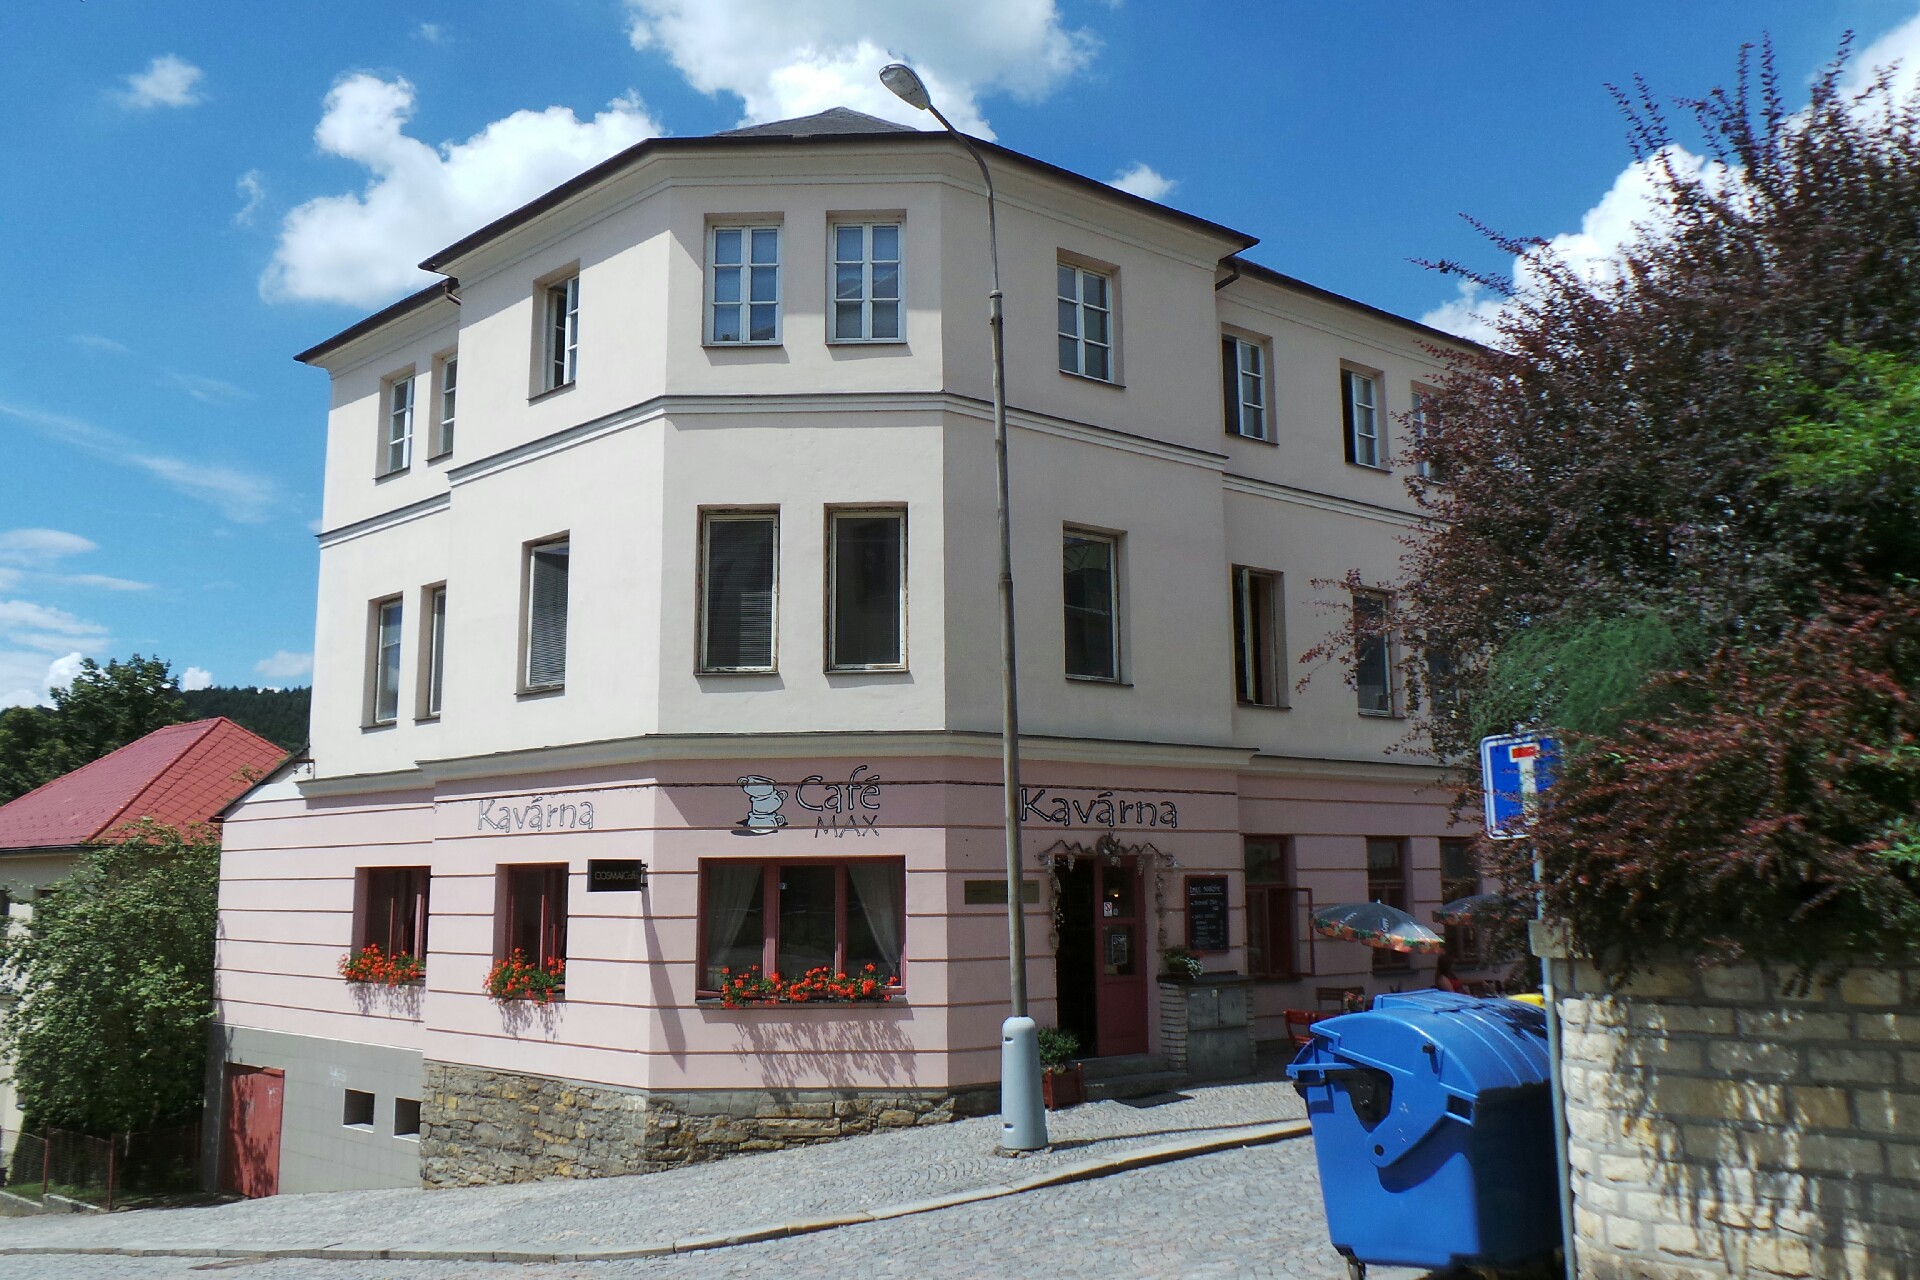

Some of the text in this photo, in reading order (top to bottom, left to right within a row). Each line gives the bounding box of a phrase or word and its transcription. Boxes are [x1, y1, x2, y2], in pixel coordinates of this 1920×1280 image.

[796, 765, 880, 813] Café
[1020, 788, 1177, 828] Kavárna
[478, 796, 594, 833] Kavárna
[814, 815, 880, 838] MAX
